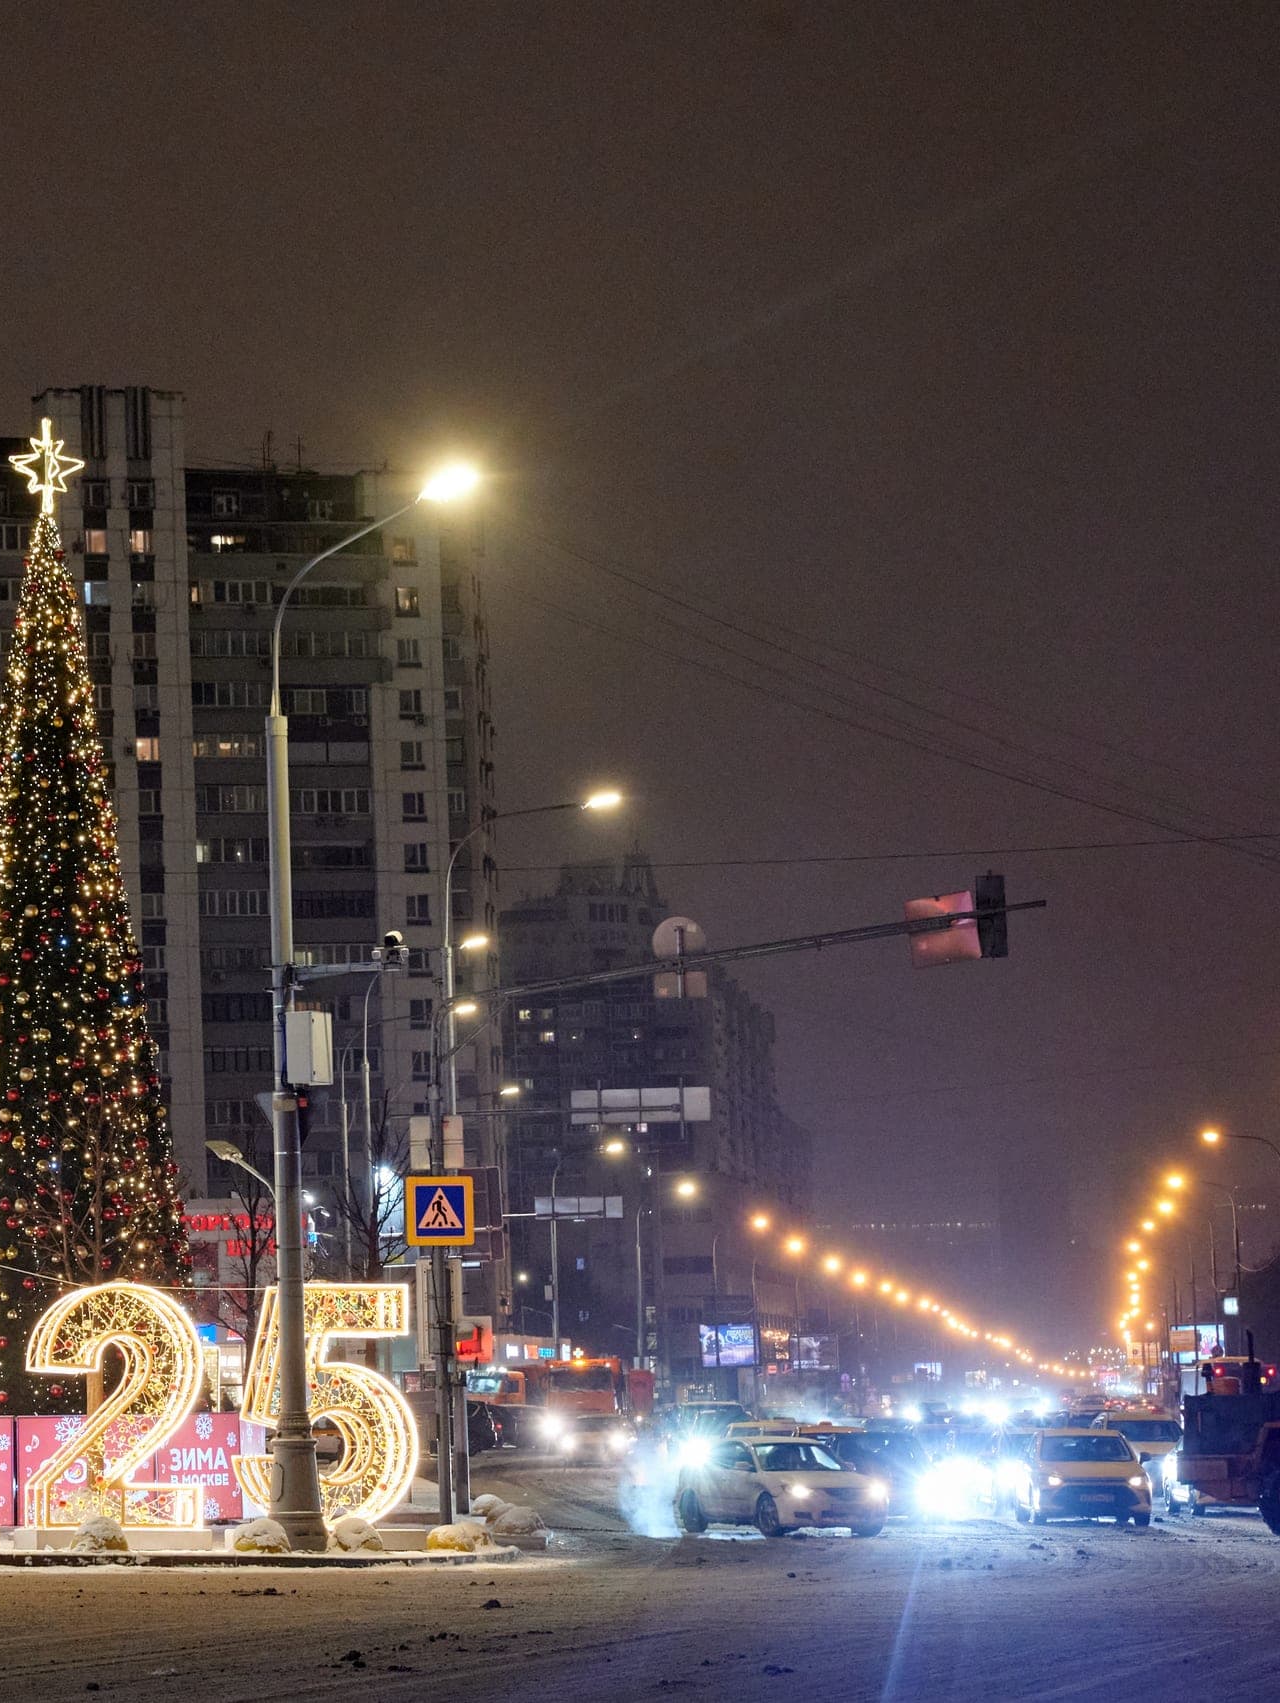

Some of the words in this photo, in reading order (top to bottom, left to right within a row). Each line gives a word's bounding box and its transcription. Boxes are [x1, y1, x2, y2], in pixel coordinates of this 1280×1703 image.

[170, 1447, 229, 1471] ЗИМА
[171, 1475, 180, 1485] В
[183, 1473, 229, 1486] МОСКВЕ
